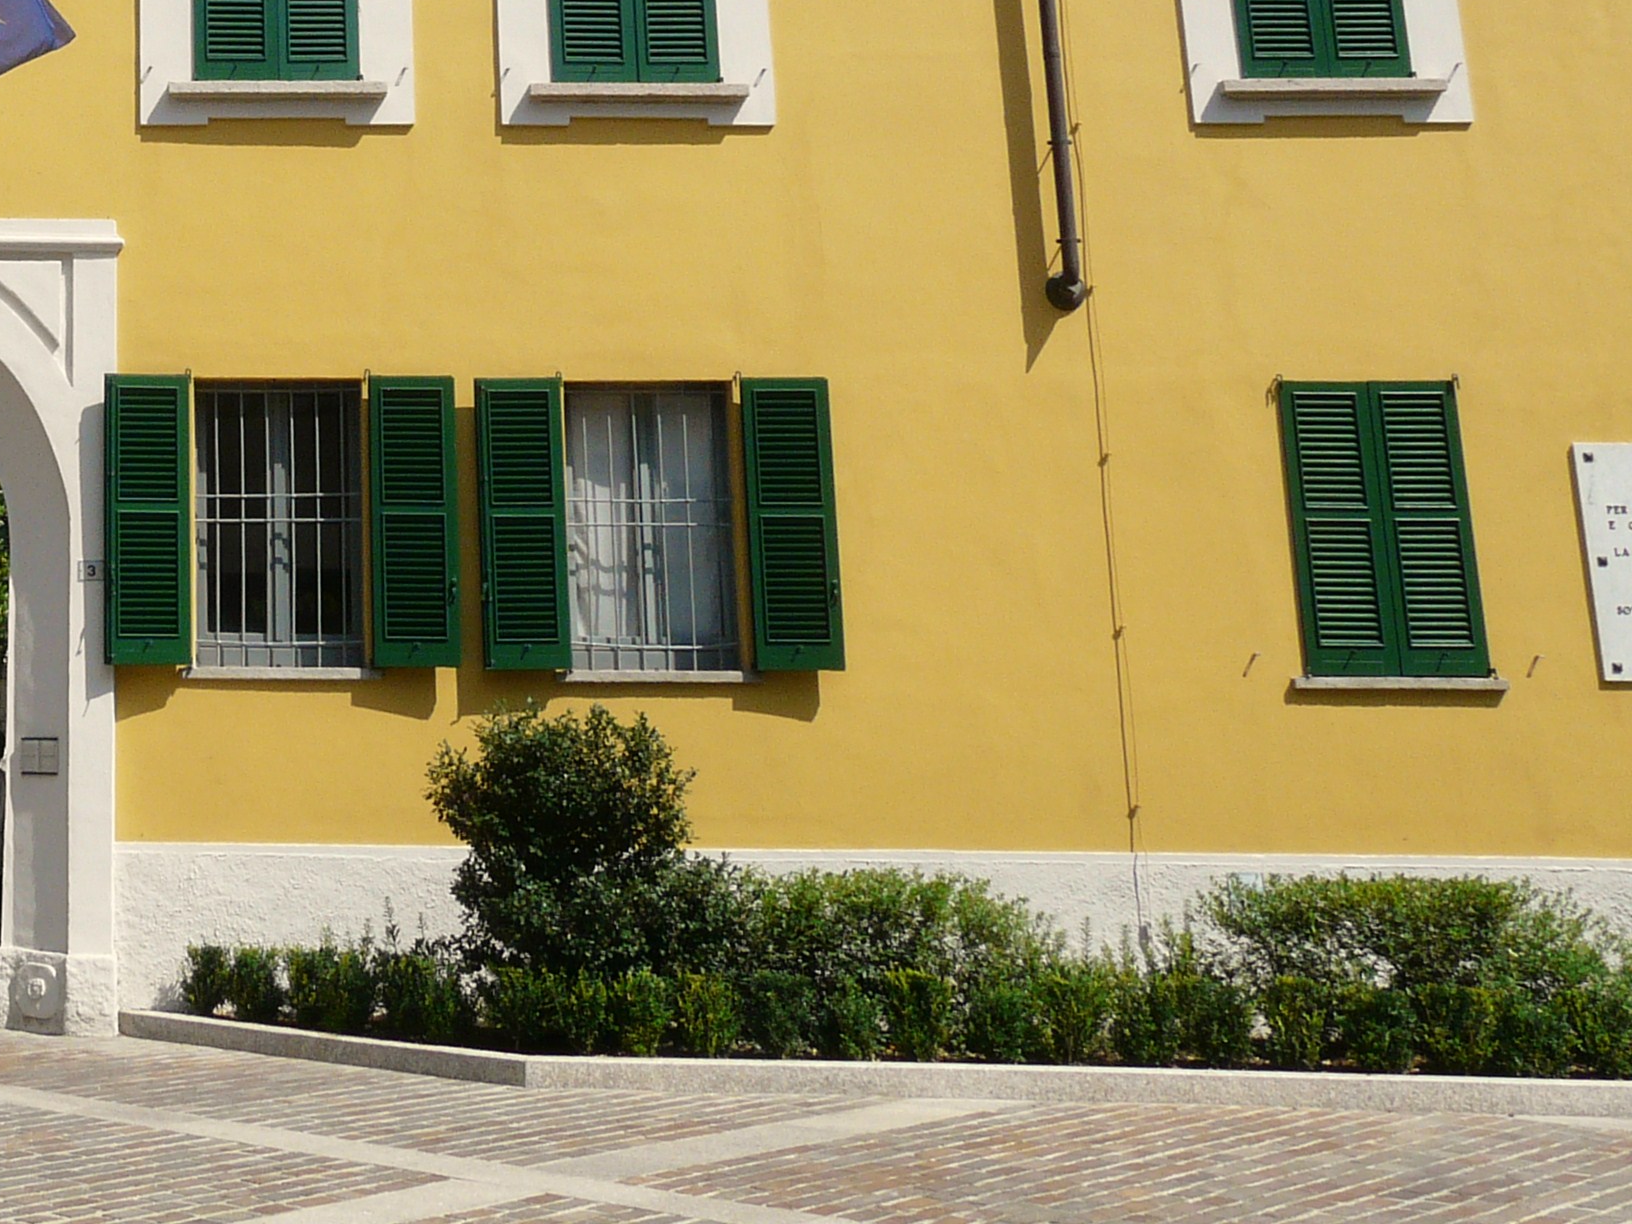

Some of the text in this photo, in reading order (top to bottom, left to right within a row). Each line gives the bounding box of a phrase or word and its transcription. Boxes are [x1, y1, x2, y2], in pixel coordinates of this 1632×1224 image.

[1606, 505, 1628, 515] PER
[1608, 520, 1616, 530] E
[1614, 547, 1630, 557] LA
[87, 564, 96, 577] 3
